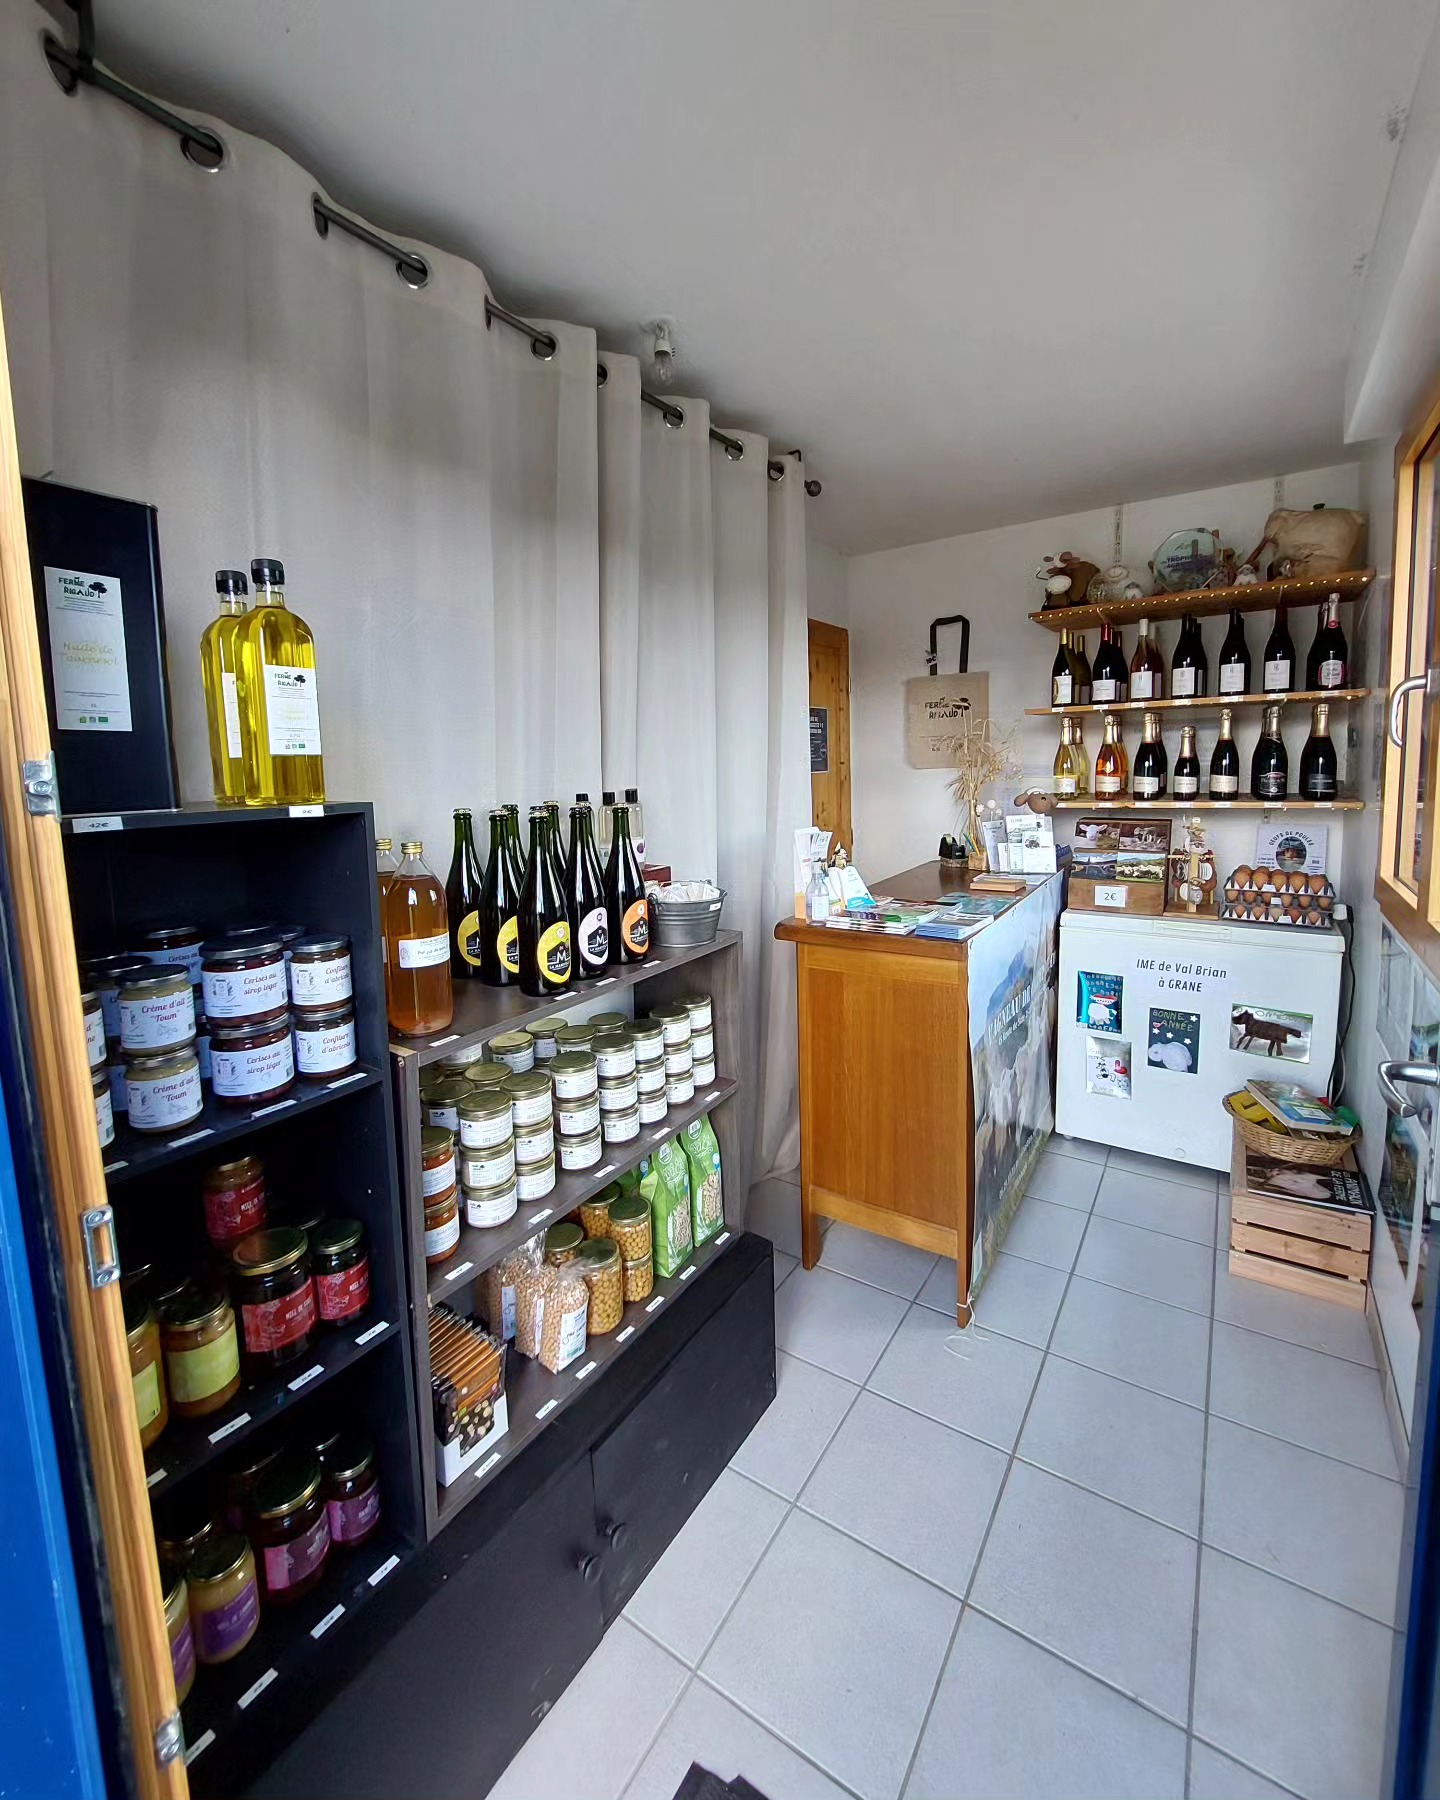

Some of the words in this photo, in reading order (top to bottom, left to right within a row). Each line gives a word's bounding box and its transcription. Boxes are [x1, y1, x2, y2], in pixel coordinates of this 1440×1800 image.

[58, 576, 85, 588] FERME
[63, 586, 95, 598] RIGAUD
[1104, 892, 1117, 902] 2€
[1136, 958, 1156, 971] IME
[1158, 961, 1172, 972] de
[1175, 962, 1193, 975] Val
[1196, 965, 1227, 979] Brian
[243, 974, 268, 985] Cerises
[269, 971, 277, 980] au
[244, 985, 263, 996] sirop
[1158, 978, 1165, 988] à
[1168, 979, 1203, 993] GRANE
[141, 1002, 168, 1014] Crème
[1152, 1009, 1185, 1021] BONNE
[1160, 1019, 1194, 1032] ANNÉE
[246, 1055, 271, 1065] Cerises
[272, 1051, 281, 1060] au
[246, 1064, 265, 1075] sirop
[265, 1059, 282, 1072] léger
[285, 1308, 297, 1320] MIEL
